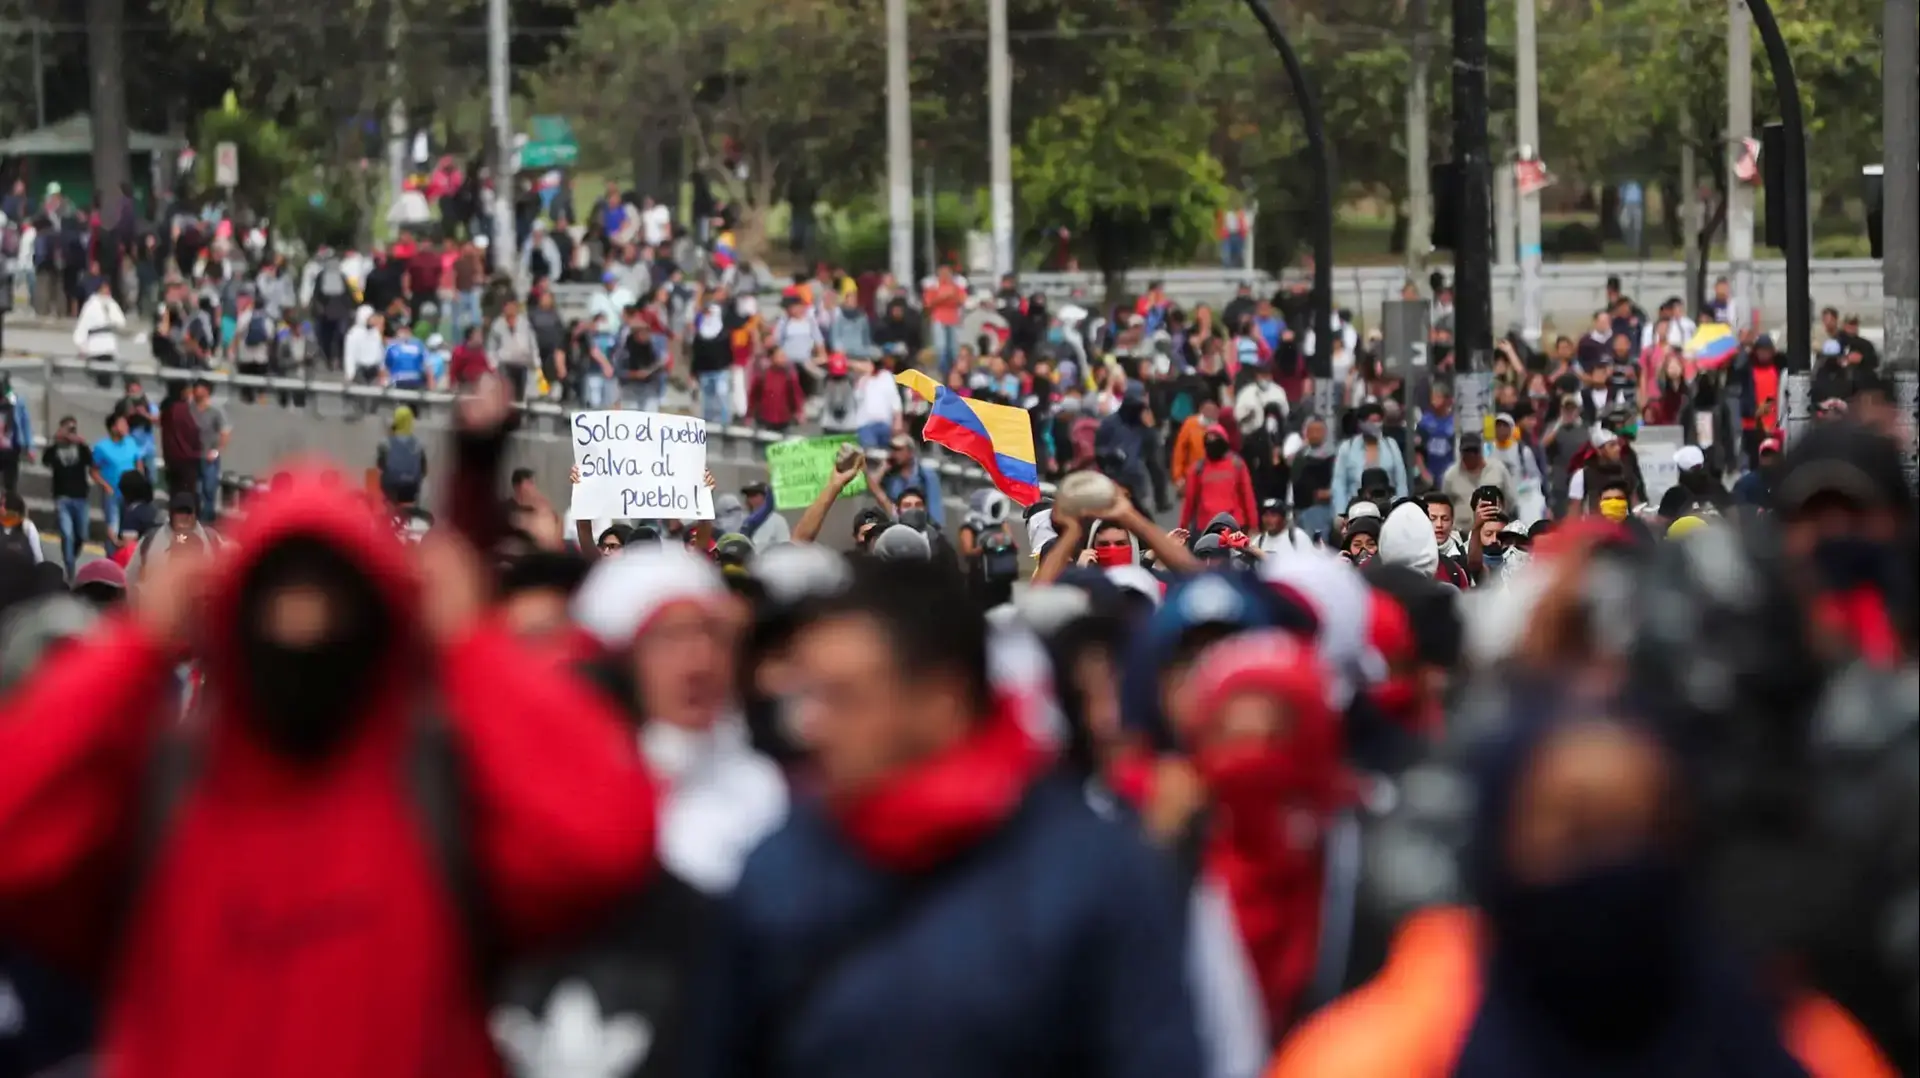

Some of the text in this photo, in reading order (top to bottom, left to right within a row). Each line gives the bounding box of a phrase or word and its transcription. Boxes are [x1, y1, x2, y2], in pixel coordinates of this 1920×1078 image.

[575, 414, 707, 457] Solo el pueblo
[651, 454, 674, 477] al
